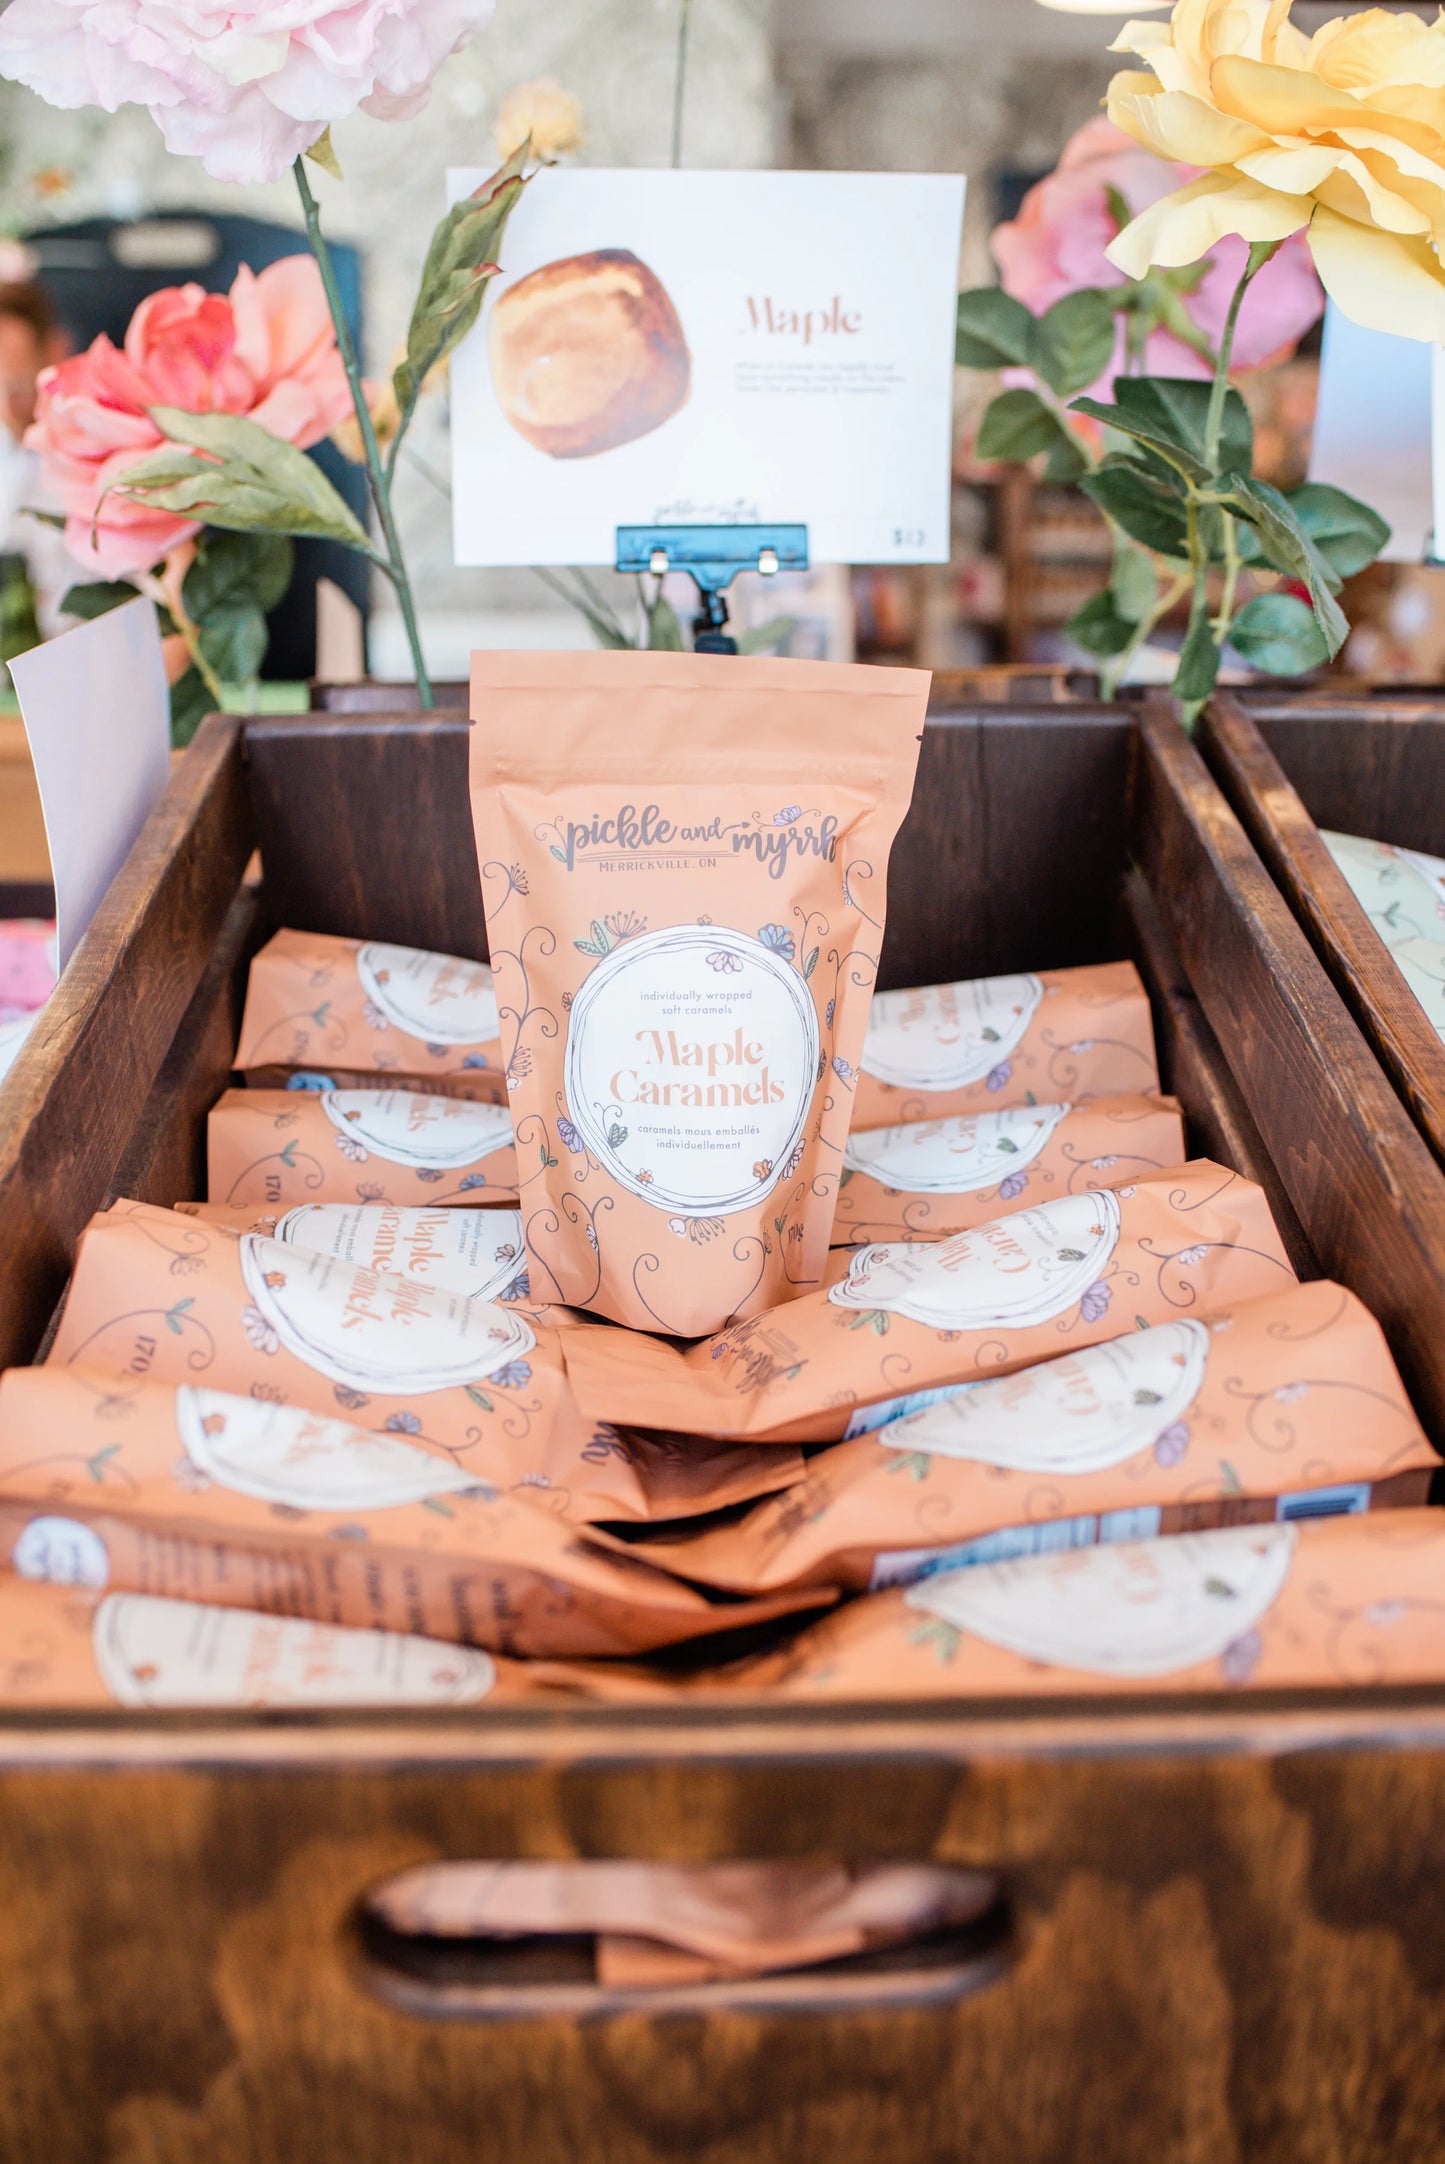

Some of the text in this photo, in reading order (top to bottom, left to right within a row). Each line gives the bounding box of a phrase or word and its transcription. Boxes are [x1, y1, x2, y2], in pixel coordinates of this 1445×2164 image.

[738, 296, 862, 345] Maple
[567, 804, 838, 879] pickle and myrrh
[699, 857, 717, 869] ON
[640, 989, 752, 1002] individually wrapped
[662, 1004, 733, 1015] soft caramels
[635, 1026, 764, 1076] Maple
[609, 1066, 785, 1107] Caramels
[638, 1124, 760, 1136] caramels mous emballés
[656, 1138, 741, 1150] individuellement
[402, 1208, 452, 1274] Maple
